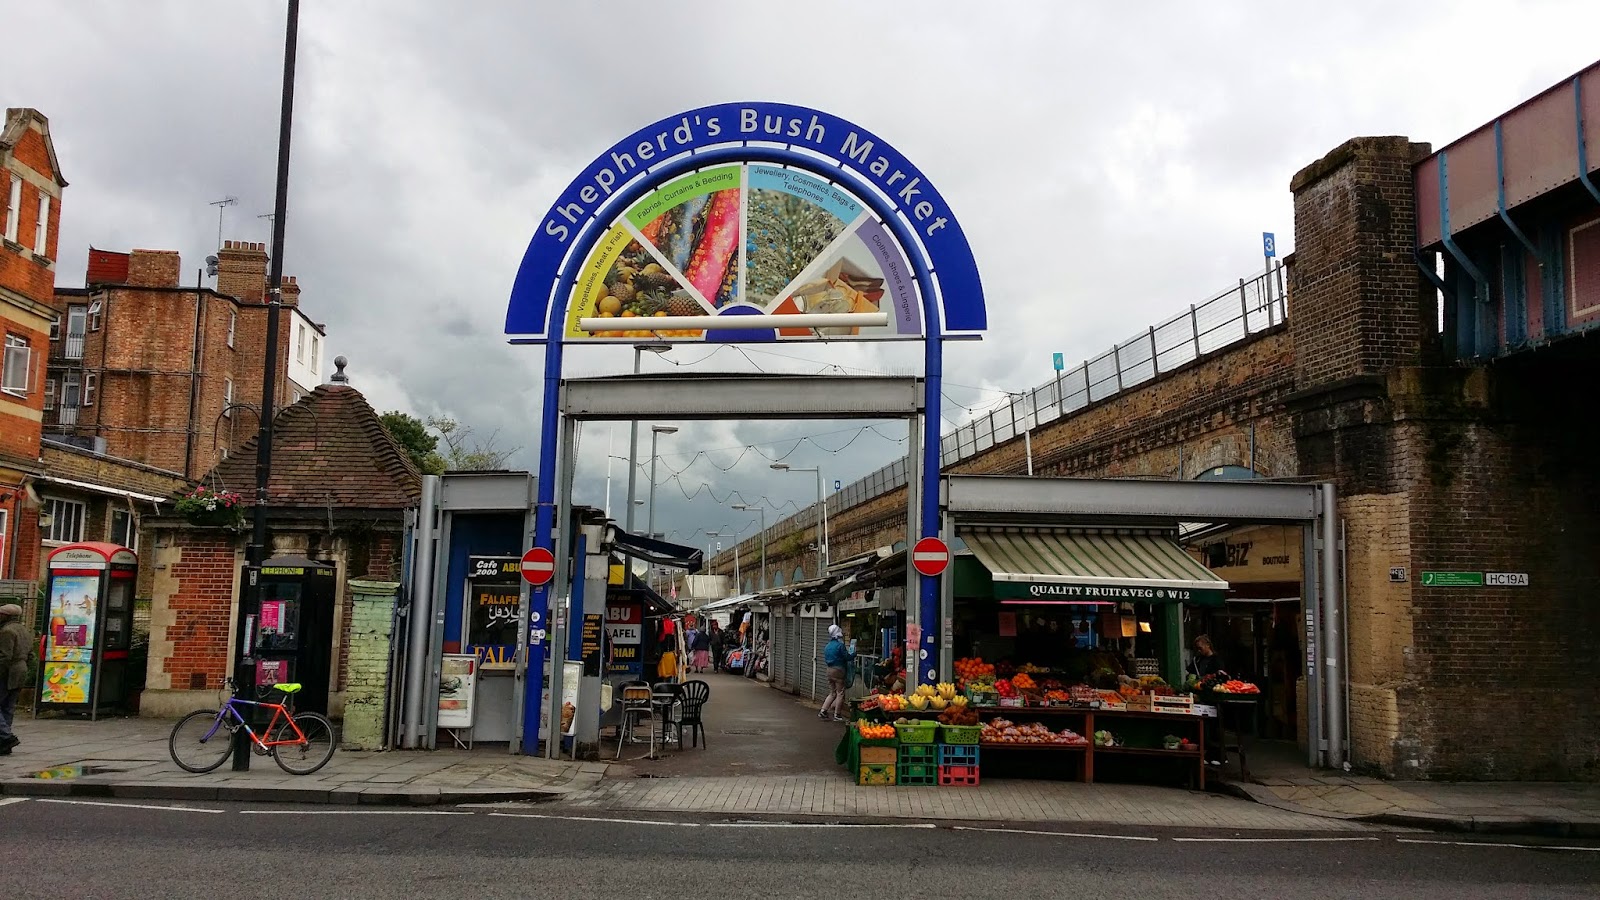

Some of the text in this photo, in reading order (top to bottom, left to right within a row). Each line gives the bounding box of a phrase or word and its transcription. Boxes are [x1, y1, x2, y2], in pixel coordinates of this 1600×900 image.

[545, 108, 949, 243] Shepherd's Bush Market
[637, 172, 733, 220] Fabrics, Curtains & Bedding
[754, 167, 856, 211] Jewellery, Cosmetics, Bags &
[783, 181, 825, 203] Telephones
[1265, 237, 1274, 251] 3
[577, 271, 600, 312] Vegetables,
[594, 252, 609, 270] Meat
[610, 230, 624, 246] Fish
[872, 234, 891, 262] Clothes,
[888, 261, 902, 285] Shoes
[900, 292, 912, 322] Lingerie
[65, 552, 92, 560] Telephone
[1262, 556, 1290, 566] BOUTIQUE
[261, 567, 299, 575] LEPHONE
[476, 560, 498, 569] Cafe
[1490, 574, 1526, 585] HC19A
[480, 593, 520, 606] FALAFE
[1029, 585, 1190, 600] QUALITY FRUIT&VEG @ W12
